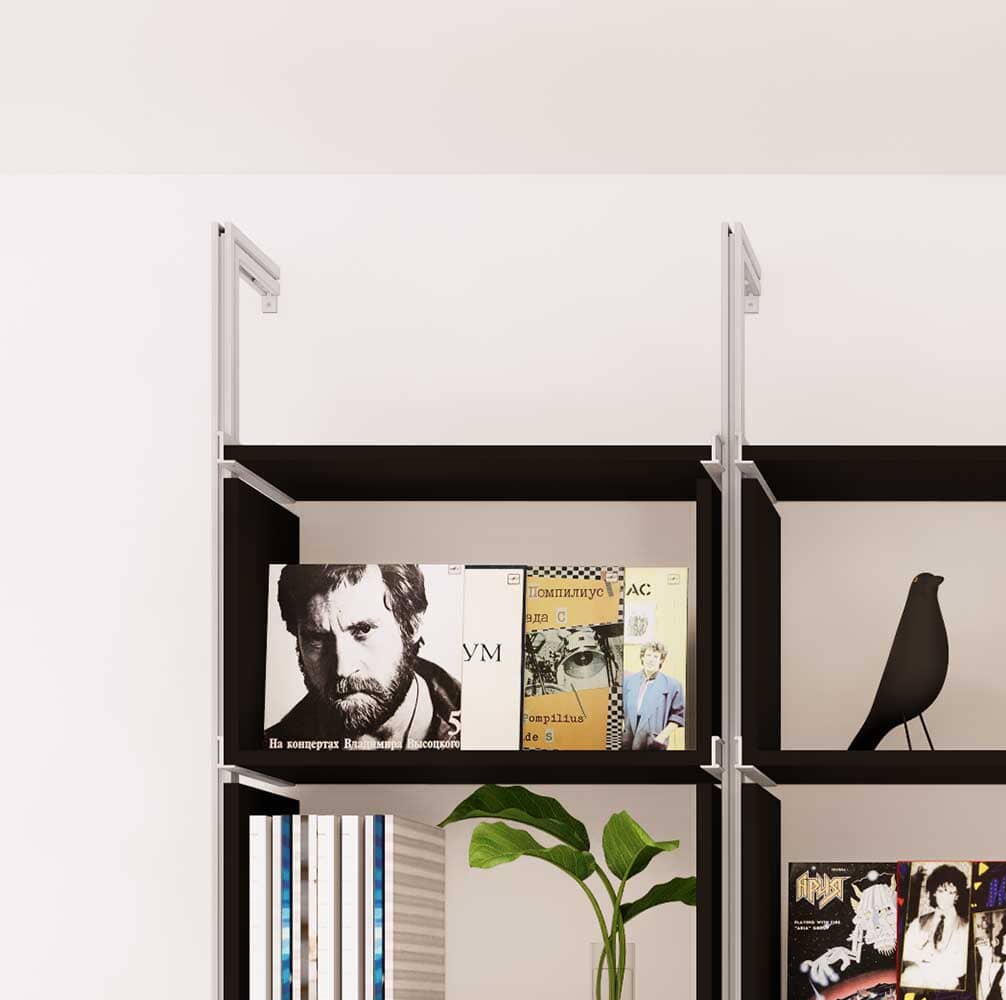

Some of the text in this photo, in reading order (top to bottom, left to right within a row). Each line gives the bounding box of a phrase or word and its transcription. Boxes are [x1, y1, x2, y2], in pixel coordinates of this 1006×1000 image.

[529, 585, 605, 600] Помпилиус
[462, 643, 502, 662] УМ
[525, 732, 539, 742] de
[269, 738, 461, 751] На концертах Владимира Высоцкого
